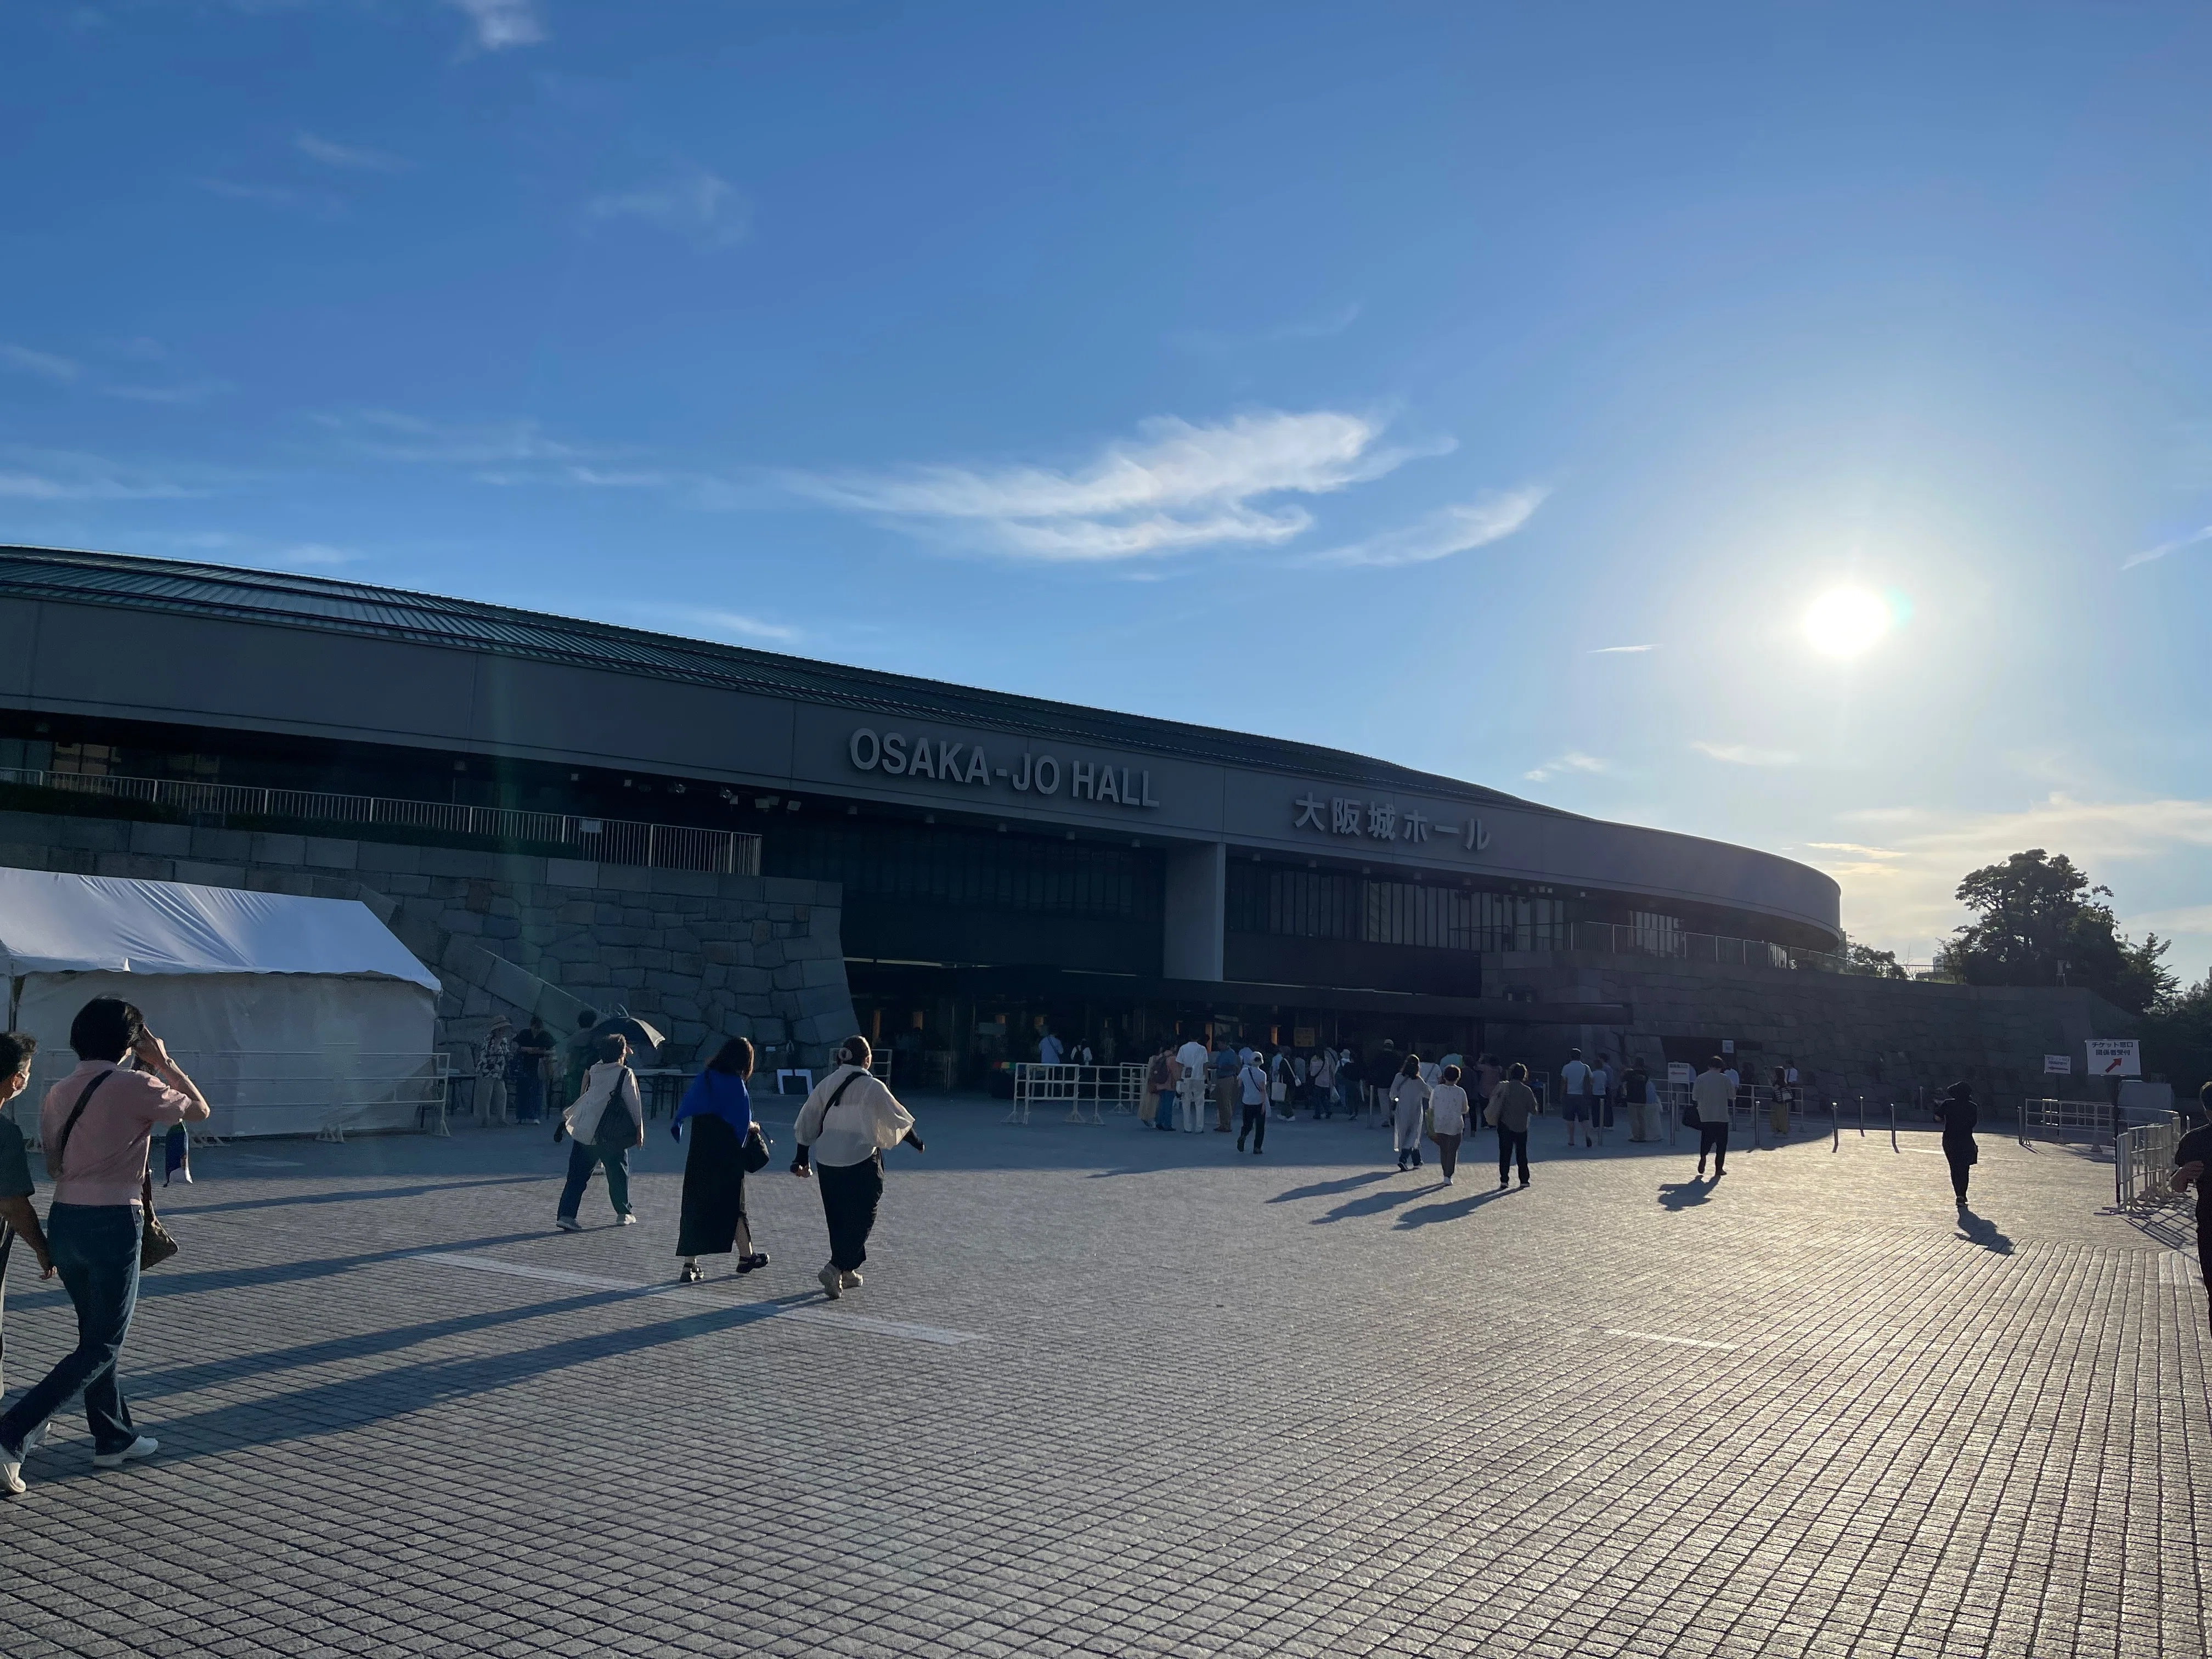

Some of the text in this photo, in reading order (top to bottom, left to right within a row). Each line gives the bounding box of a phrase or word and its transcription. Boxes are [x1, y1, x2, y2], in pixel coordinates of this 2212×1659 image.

[850, 727, 1159, 807] OSAKA-JO HALL
[1295, 792, 1490, 850] 大阪城ホール
